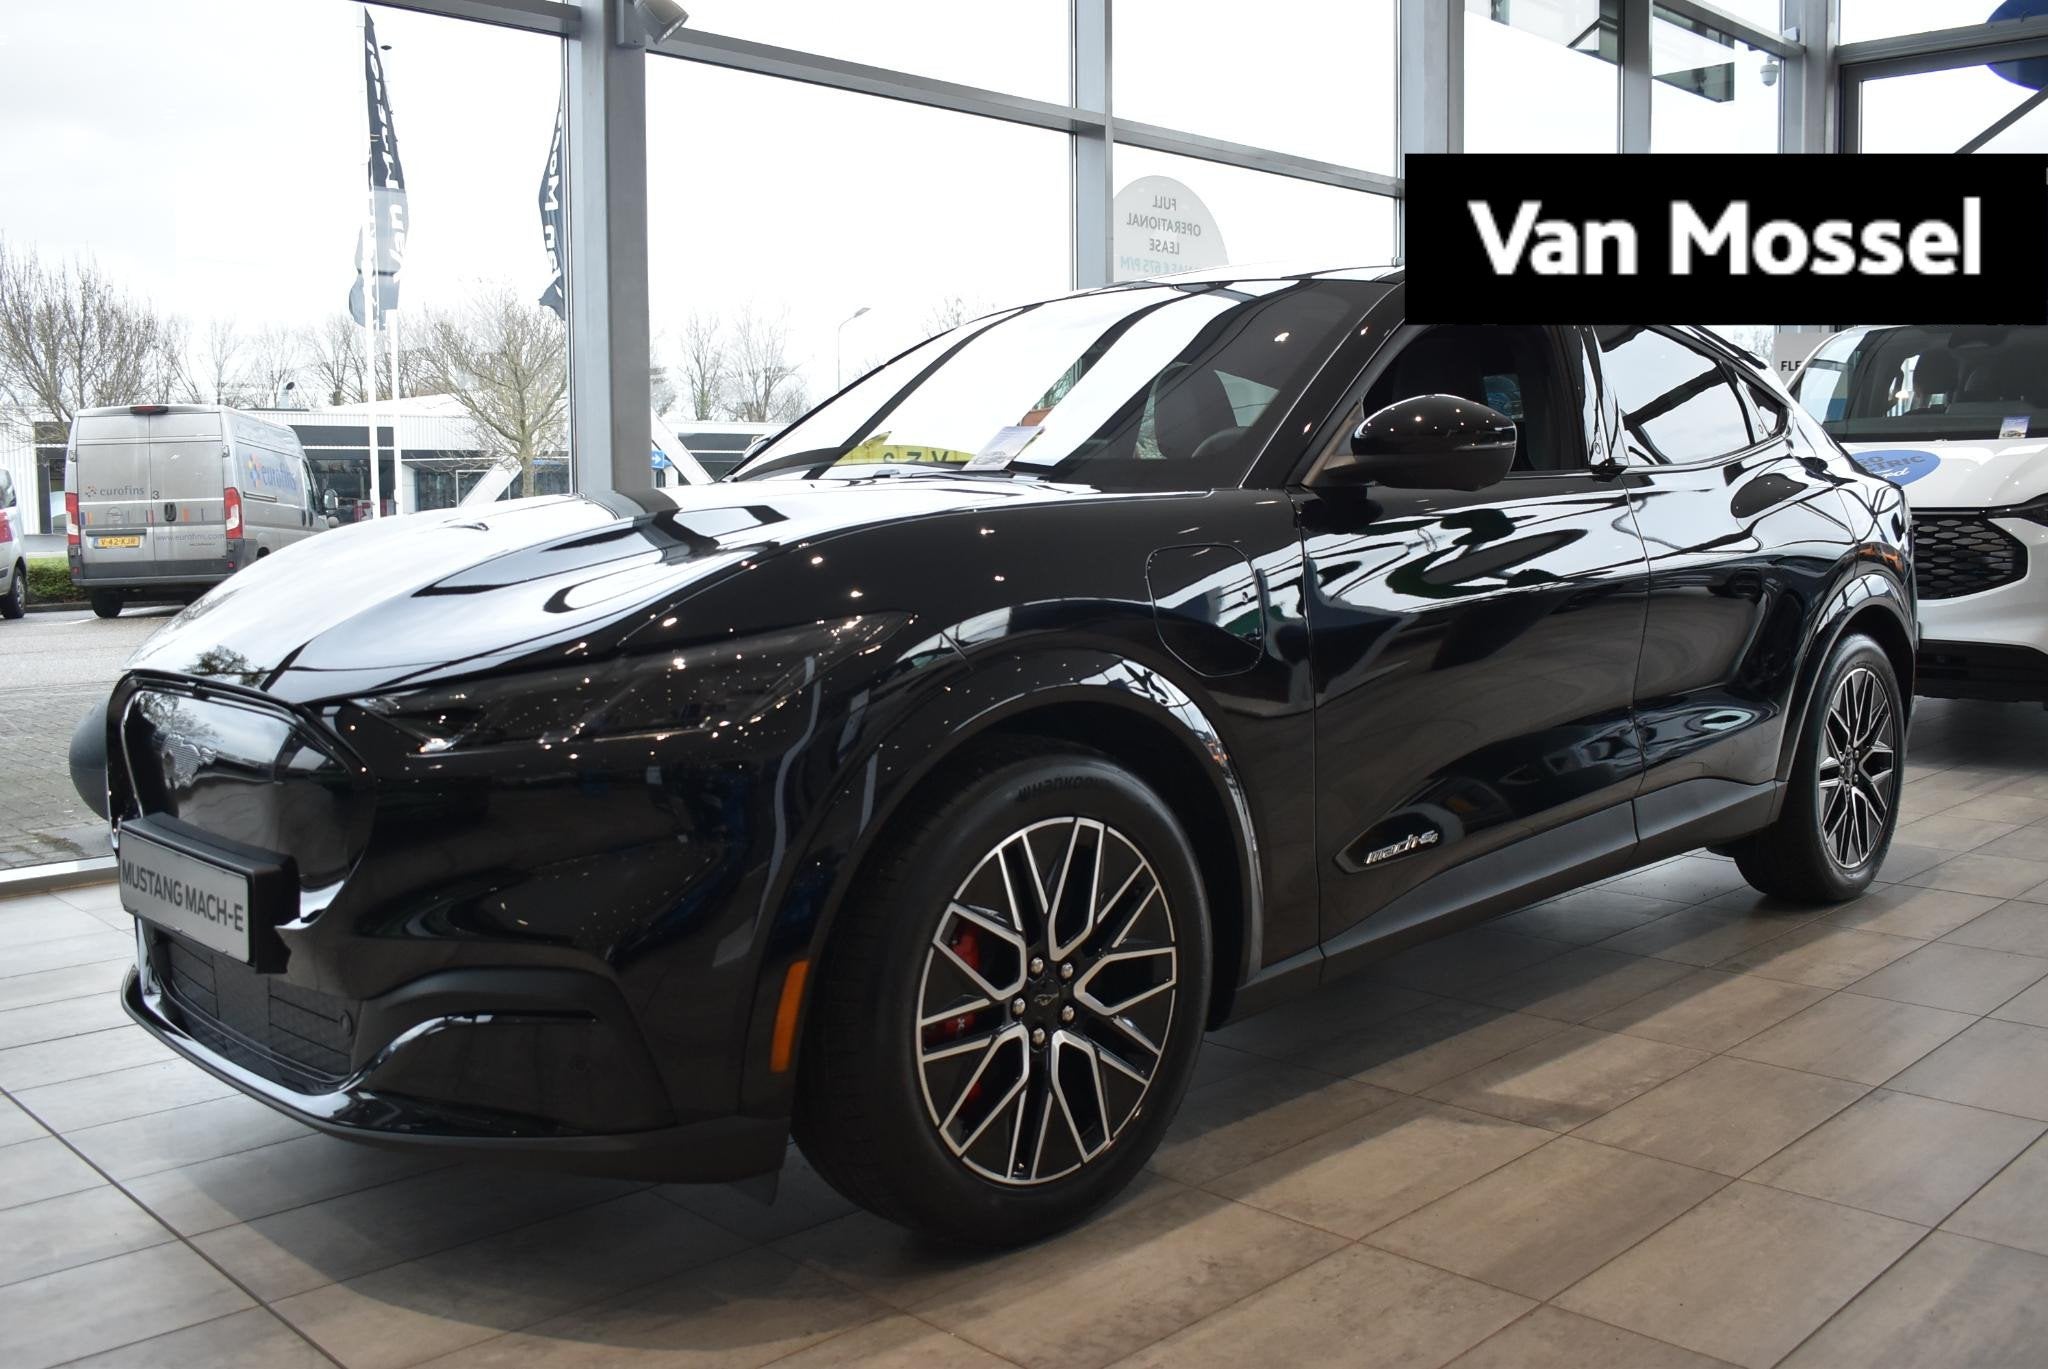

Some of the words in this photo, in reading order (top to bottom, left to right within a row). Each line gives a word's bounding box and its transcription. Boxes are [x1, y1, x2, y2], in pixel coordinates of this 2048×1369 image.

[100, 485, 145, 497] eurofins
[152, 490, 160, 500] 3
[121, 859, 184, 907] MUSTANG
[185, 884, 245, 933] MACH-E
